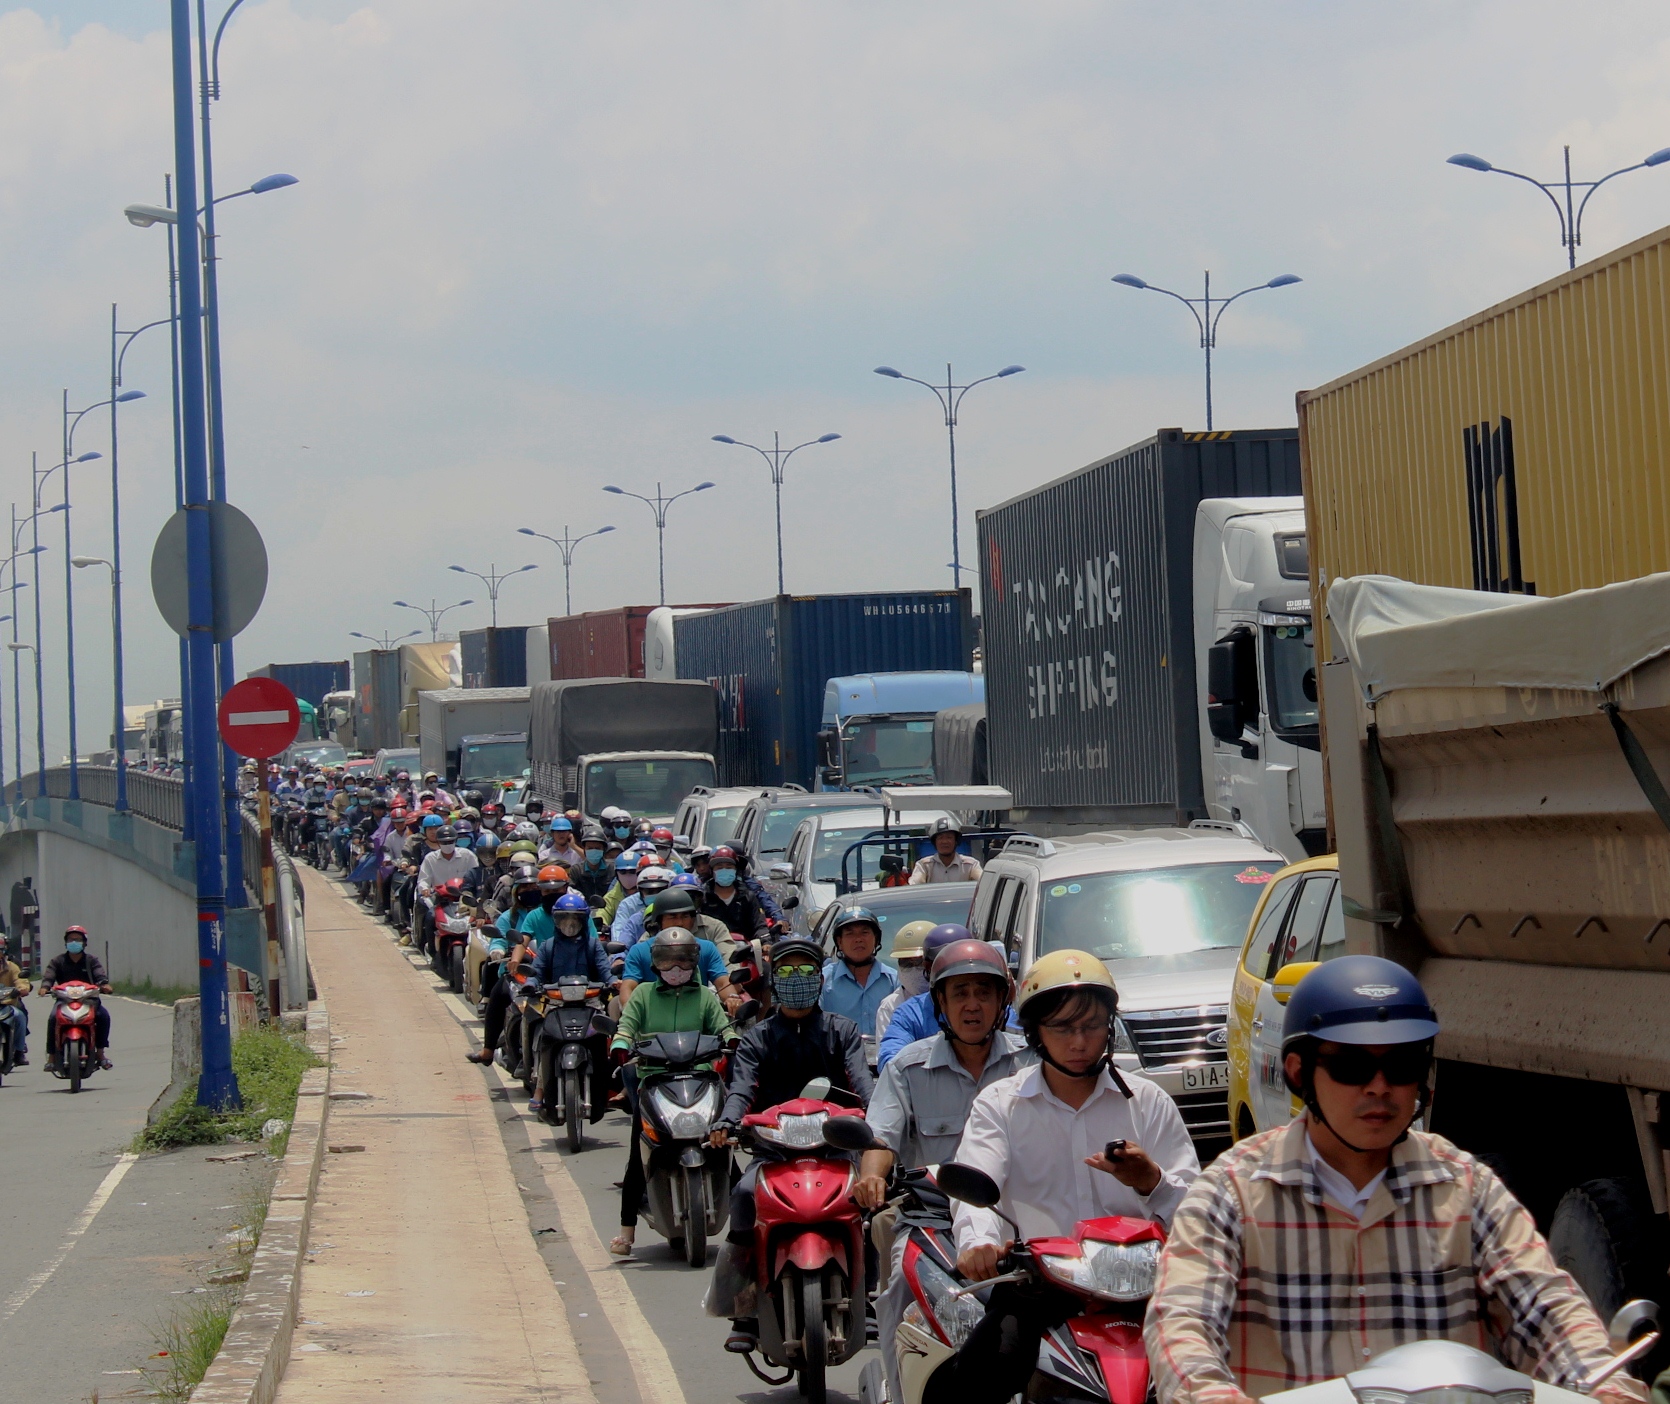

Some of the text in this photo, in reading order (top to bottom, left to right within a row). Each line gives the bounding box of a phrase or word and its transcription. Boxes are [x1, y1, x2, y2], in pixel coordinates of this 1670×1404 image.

[1056, 550, 1122, 635] CANG
[1028, 650, 1118, 719] SHIPPING
[1104, 1320, 1140, 1329] HONDA
